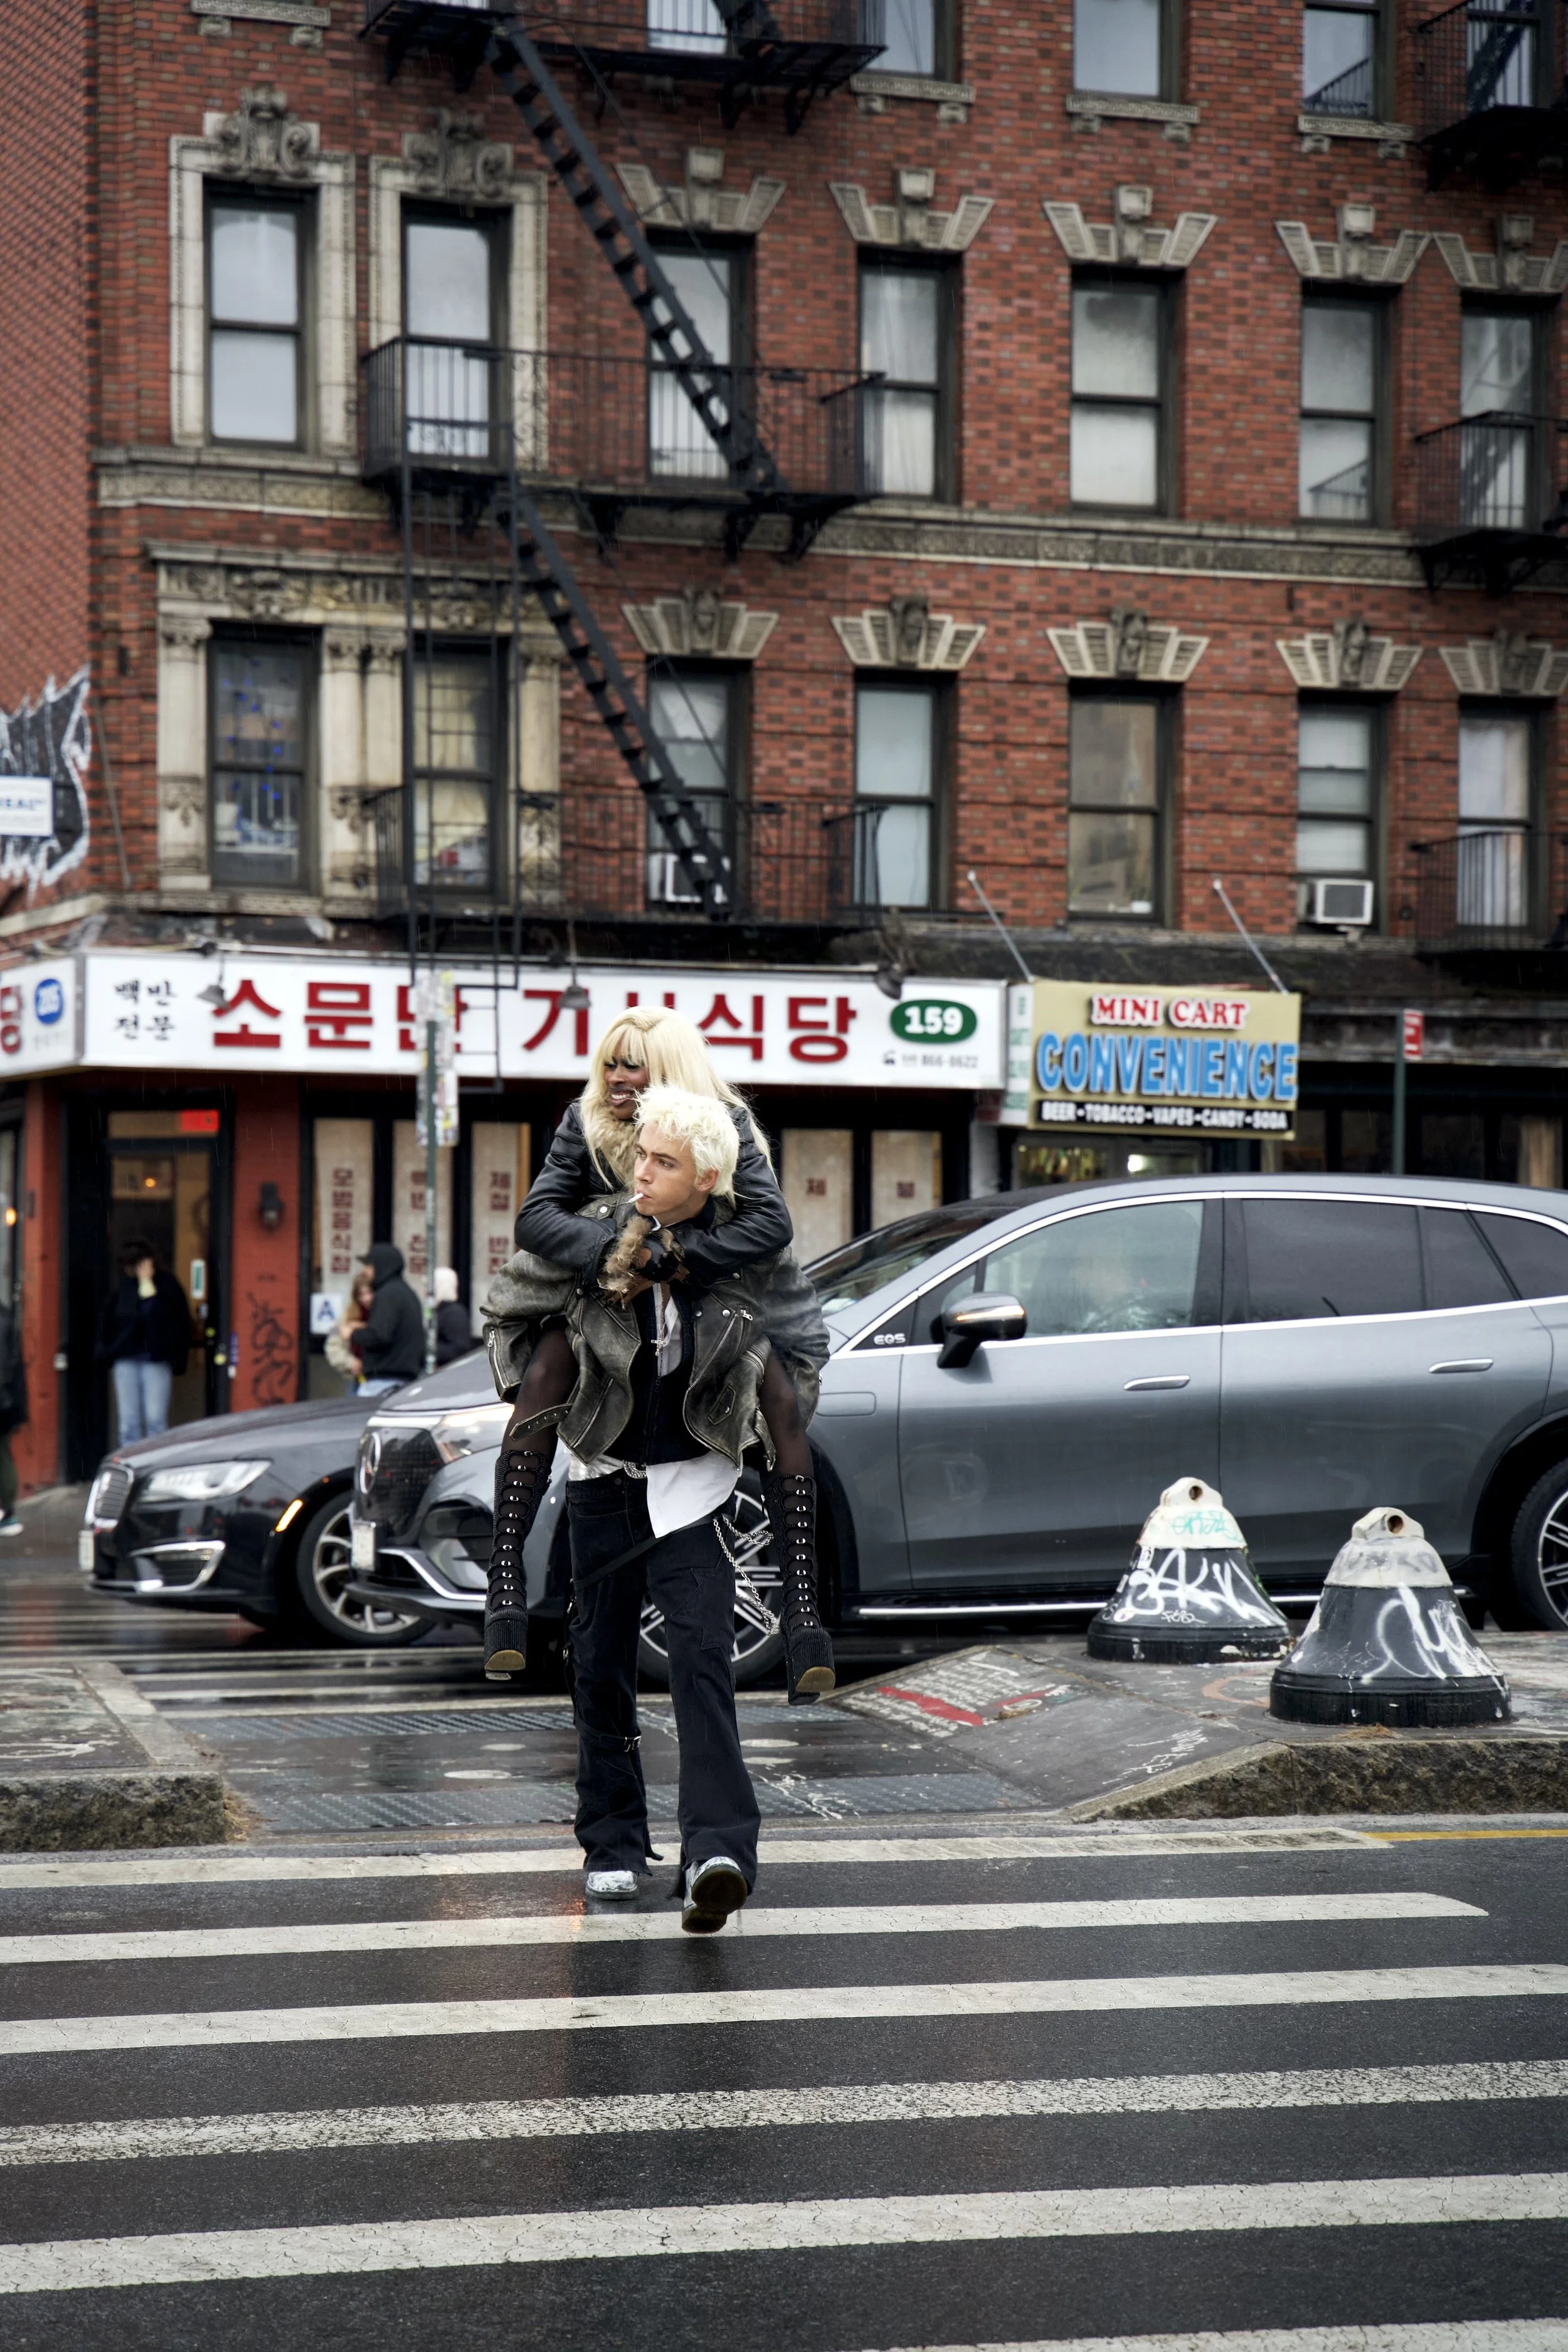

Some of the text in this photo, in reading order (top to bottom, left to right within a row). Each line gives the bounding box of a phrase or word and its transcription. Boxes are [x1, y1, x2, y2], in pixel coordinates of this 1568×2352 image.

[114, 979, 178, 1006] 백반
[904, 1005, 964, 1036] 159
[1093, 995, 1248, 1028] MINI CART
[114, 1014, 177, 1041] 전문
[1037, 1030, 1299, 1102] CONVENIENCE
[1041, 1101, 1288, 1131] BEER TOBACCO VAPES CANDY SODA
[317, 1300, 336, 1322] A
[873, 1333, 907, 1345] EQS
